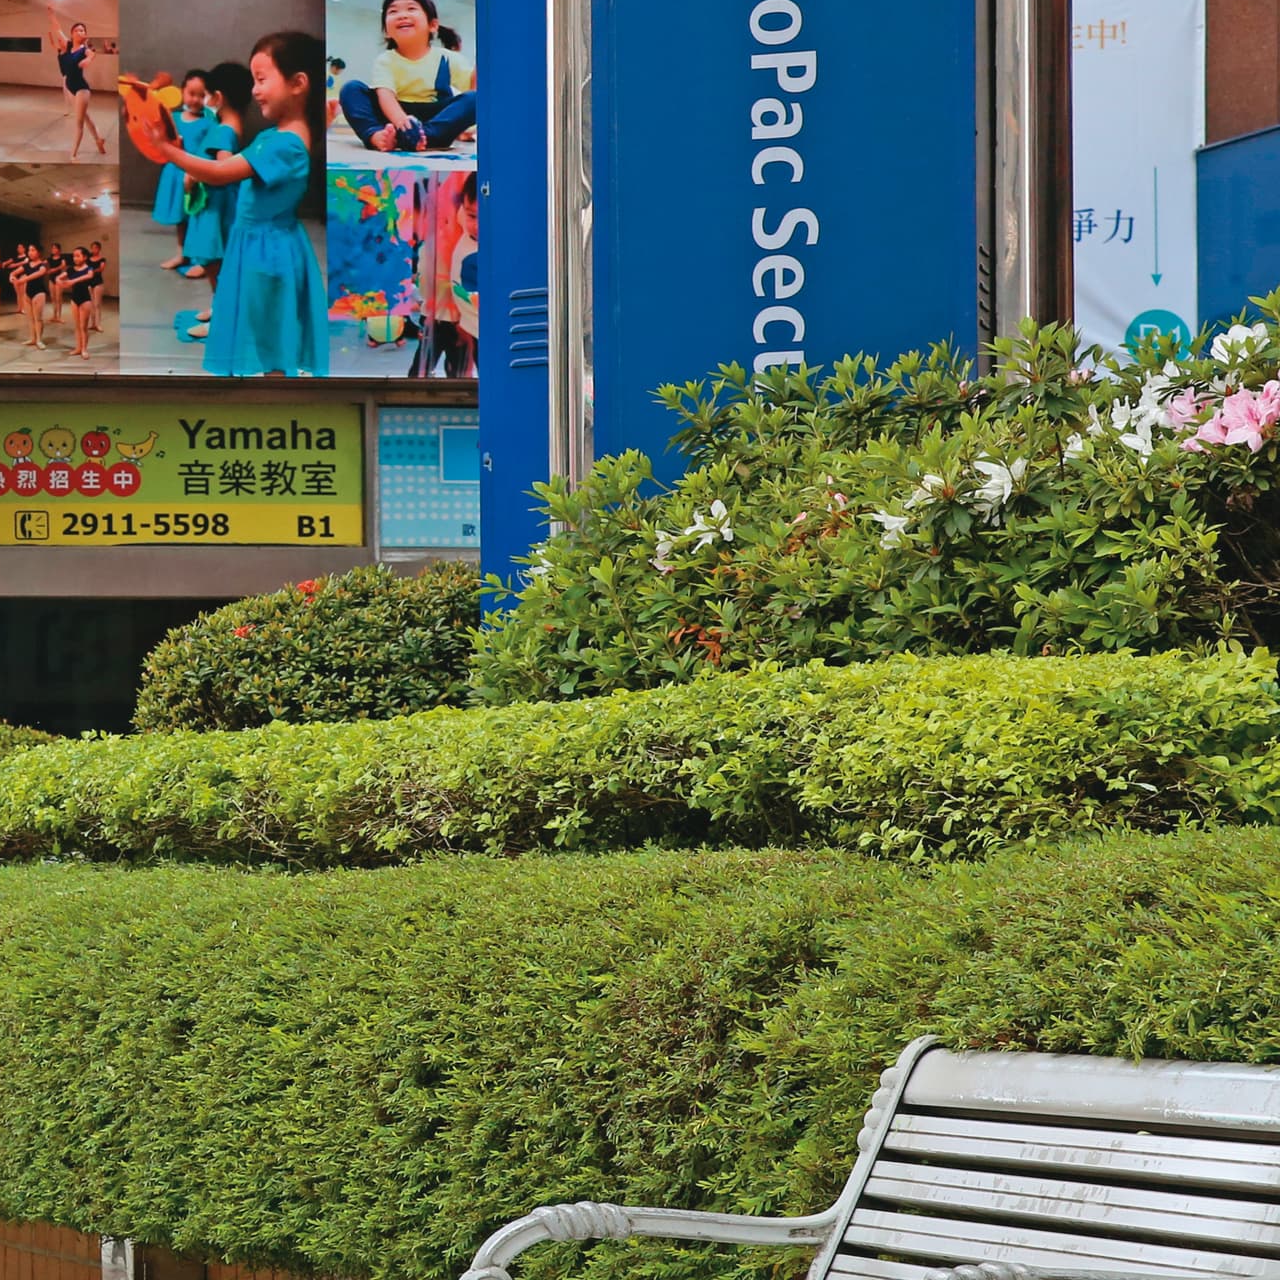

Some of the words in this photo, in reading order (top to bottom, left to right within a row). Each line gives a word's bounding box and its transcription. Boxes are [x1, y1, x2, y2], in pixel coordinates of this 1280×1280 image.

[178, 418, 337, 452] Yamaha
[178, 460, 337, 498] 音樂教室
[62, 513, 231, 537] 2911-5598
[297, 514, 336, 538] B1
